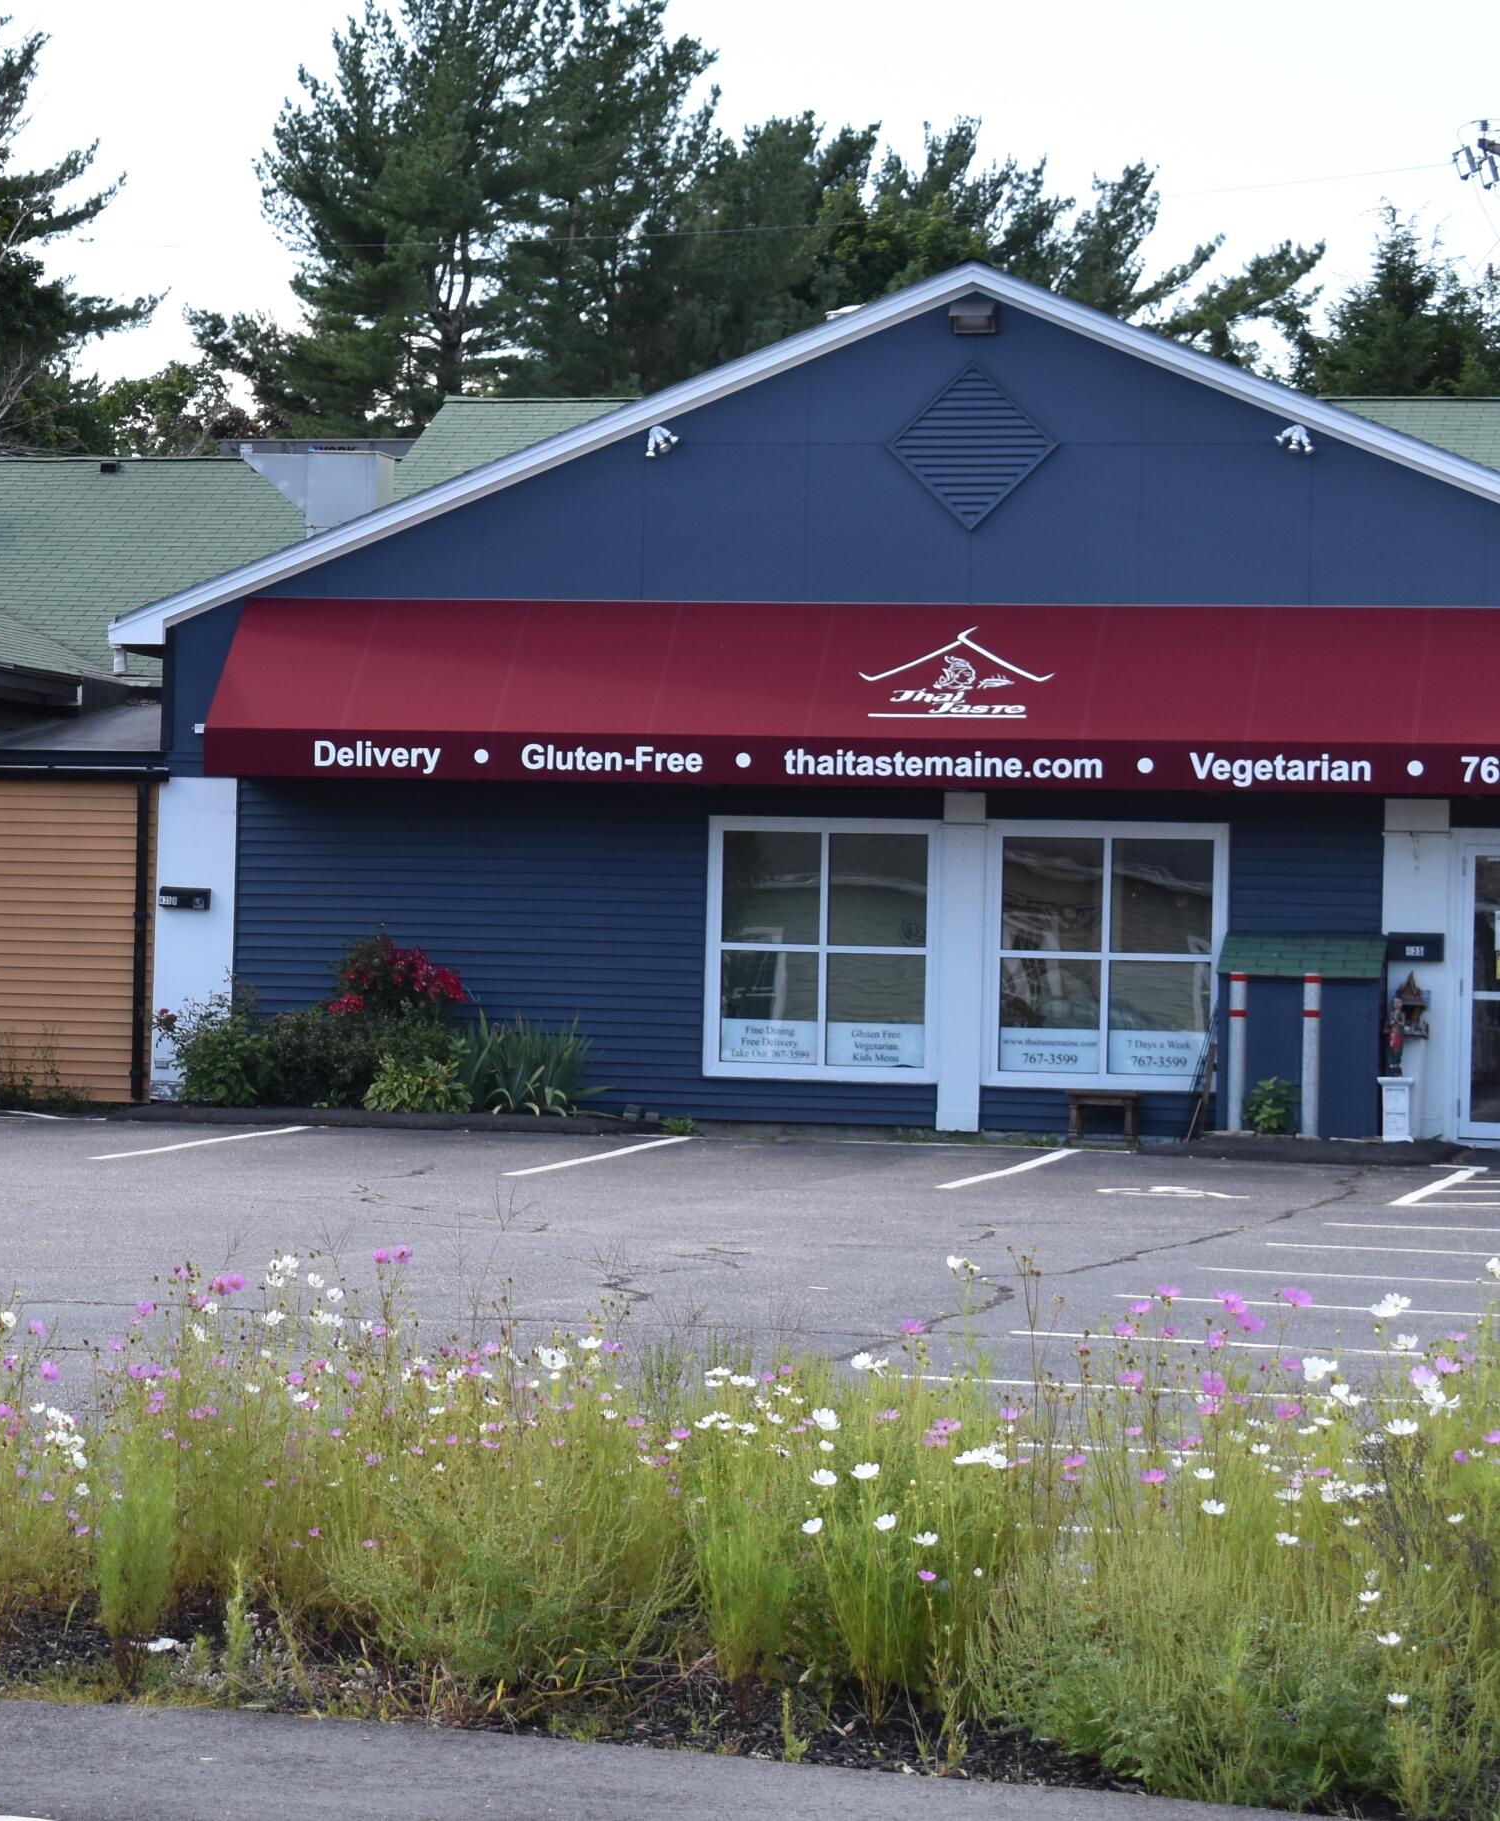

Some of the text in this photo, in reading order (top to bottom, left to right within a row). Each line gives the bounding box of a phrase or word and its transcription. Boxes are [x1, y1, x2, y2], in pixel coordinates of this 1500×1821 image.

[890, 688, 966, 703] Thai
[314, 740, 441, 775] Delivery
[521, 743, 703, 773] Gluten-Free
[783, 749, 1103, 779] thaitastemaine.com
[1189, 752, 1372, 788] Vegetarian
[1460, 756, 1500, 784] 76
[745, 1025, 795, 1037] Fine Dining
[851, 1029, 901, 1039] Gluten Free
[741, 1036, 799, 1049] Free Delivery
[854, 1041, 898, 1051] Vegetarian
[1127, 1039, 1133, 1048] 7
[1134, 1039, 1157, 1051] Days
[1167, 1040, 1191, 1050] Week
[853, 1053, 899, 1062] Kids Menu
[1022, 1053, 1078, 1065] 767-3599
[1131, 1055, 1188, 1067] 767-3599
